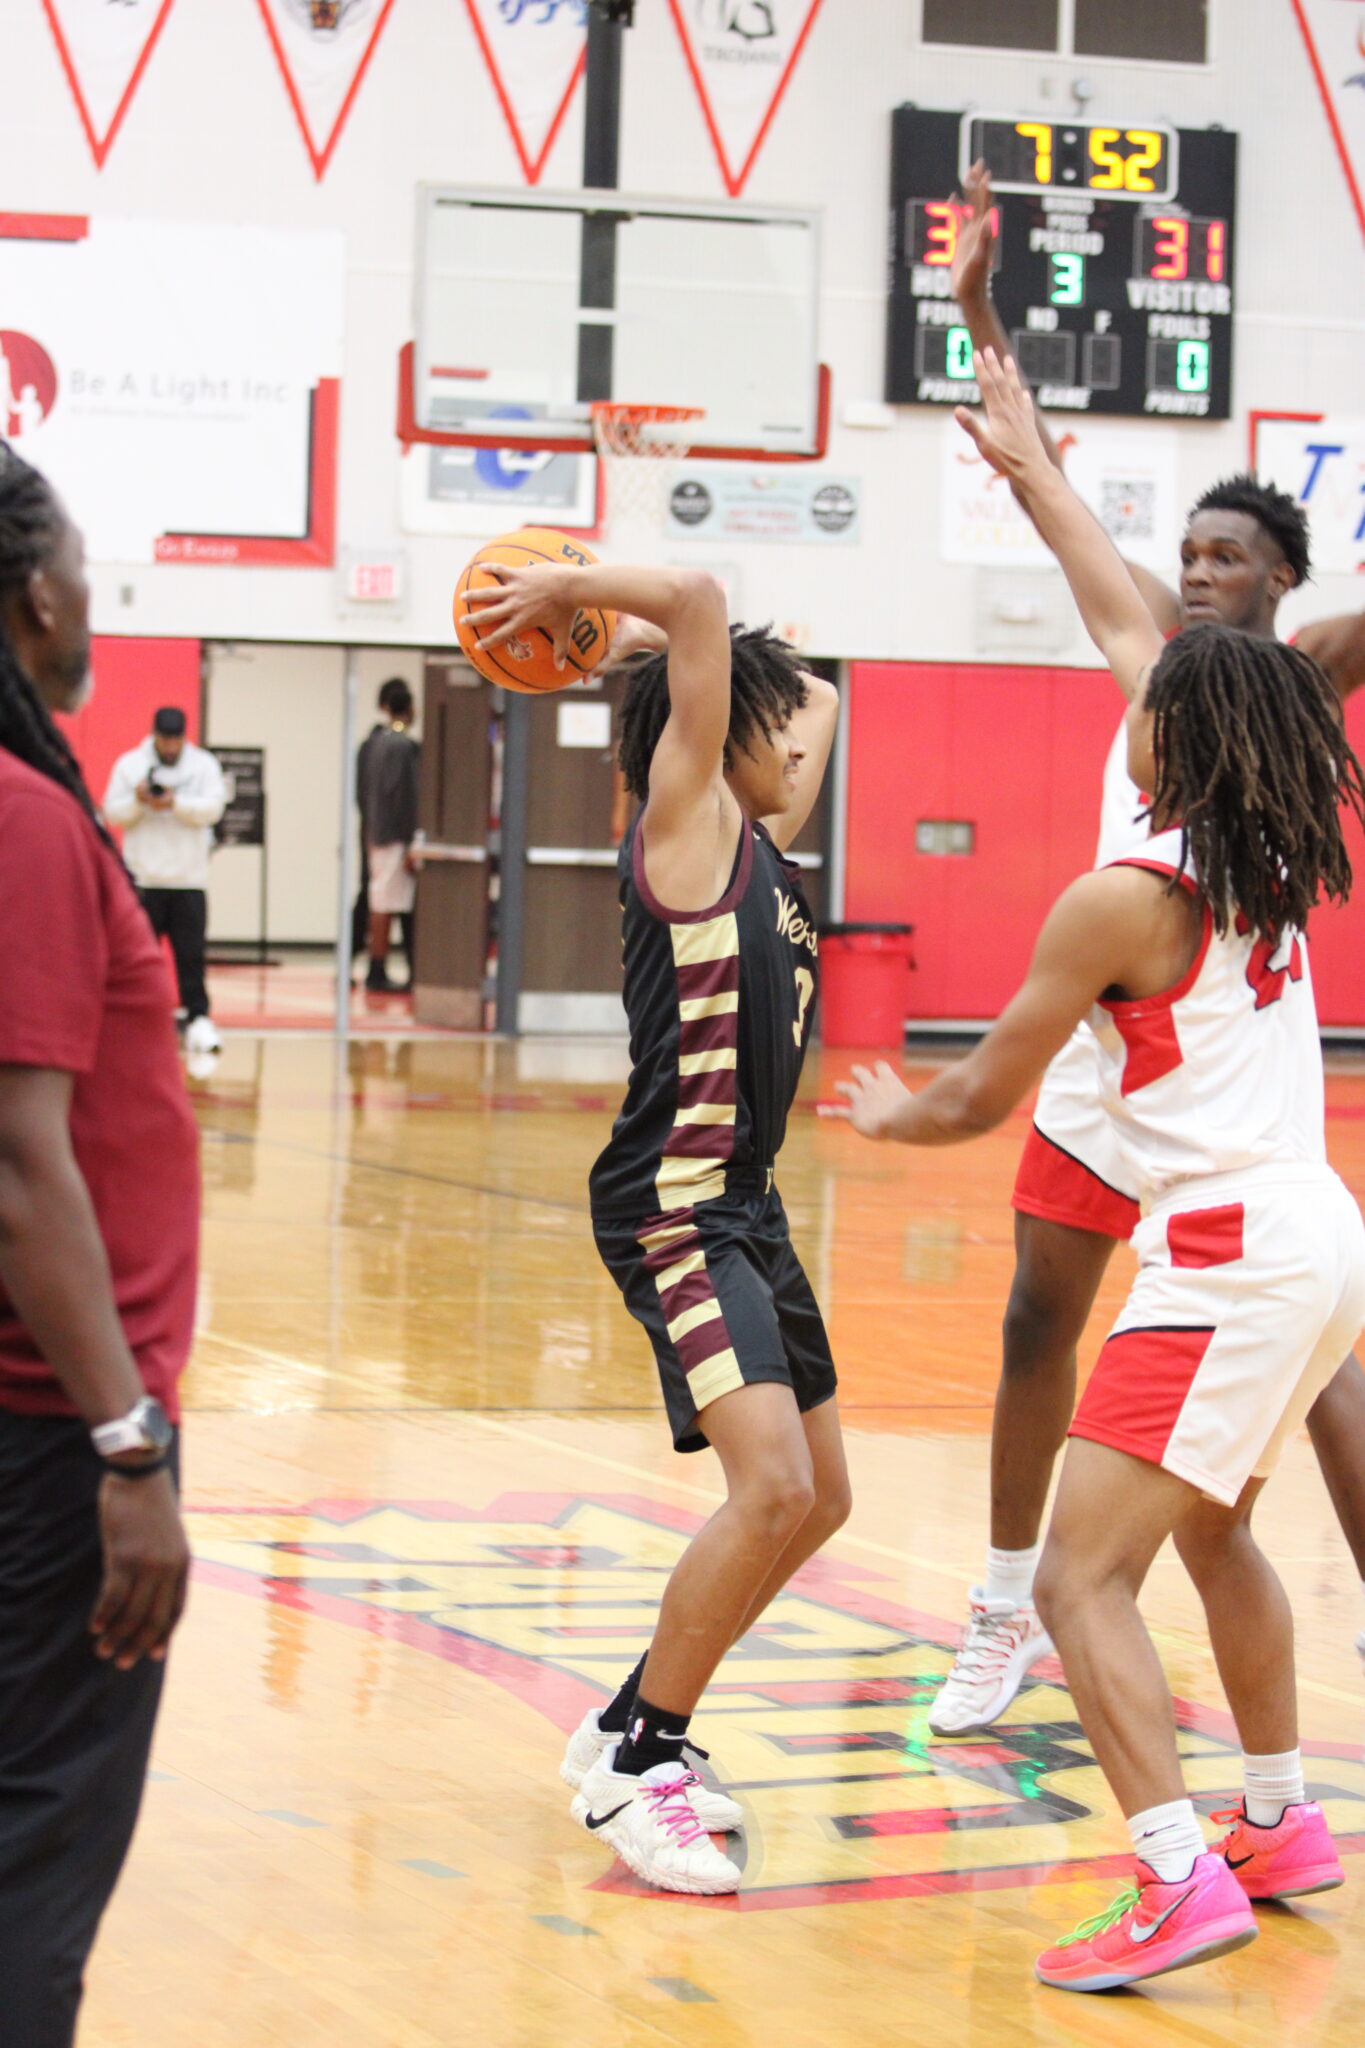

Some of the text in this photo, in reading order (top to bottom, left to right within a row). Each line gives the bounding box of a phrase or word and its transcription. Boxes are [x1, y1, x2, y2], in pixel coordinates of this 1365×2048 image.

[1015, 121, 1162, 192] 7:52
[1030, 228, 1105, 256] PERIOD
[1150, 217, 1225, 282] 31
[1050, 252, 1084, 305] 3
[1126, 278, 1232, 316] VISITOR
[1148, 313, 1211, 341] FOULS
[1176, 340, 1210, 393] 0
[150, 375, 231, 405] Light
[1144, 391, 1211, 416] POINTS
[356, 565, 394, 598] EXIT
